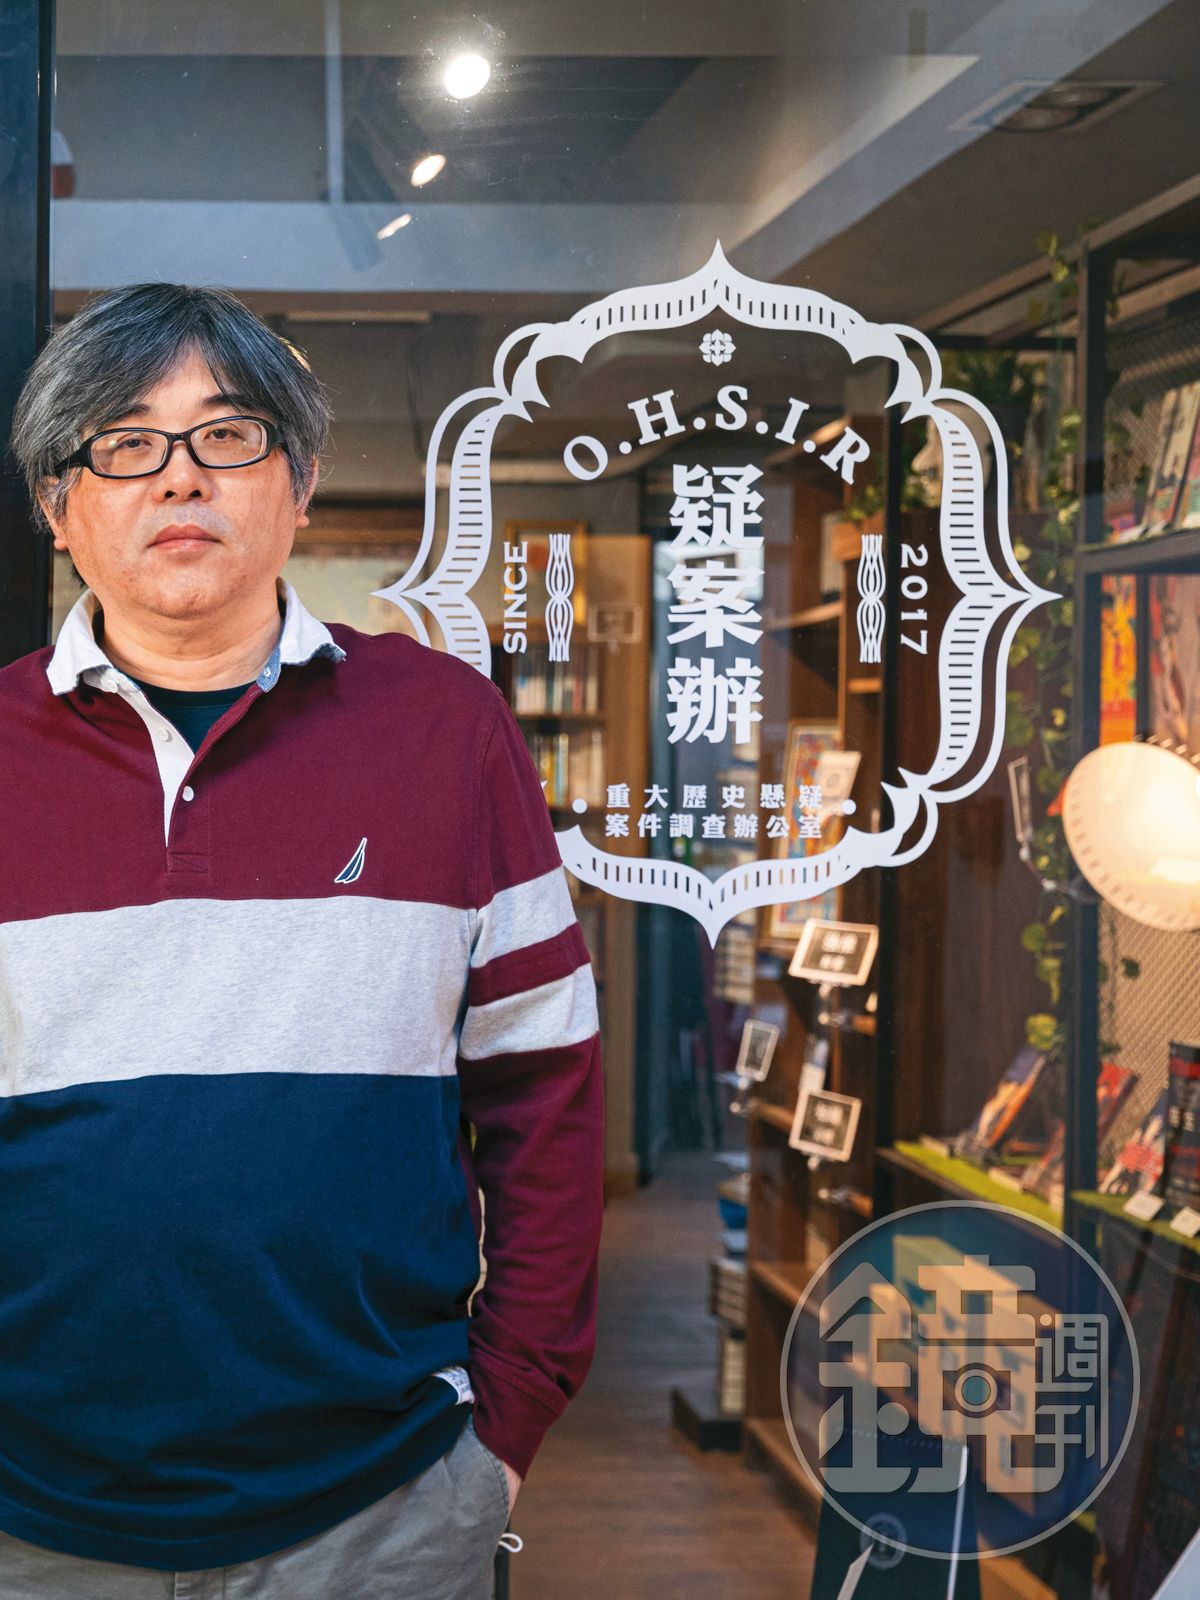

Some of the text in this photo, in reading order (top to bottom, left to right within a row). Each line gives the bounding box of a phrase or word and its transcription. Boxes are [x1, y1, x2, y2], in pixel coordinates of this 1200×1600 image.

[562, 384, 871, 486] O.H.S.I.R
[503, 541, 529, 654] SINCE
[666, 463, 766, 746] 疑案辦
[900, 544, 929, 656] 2017
[605, 813, 824, 839] 案件調查辦公室
